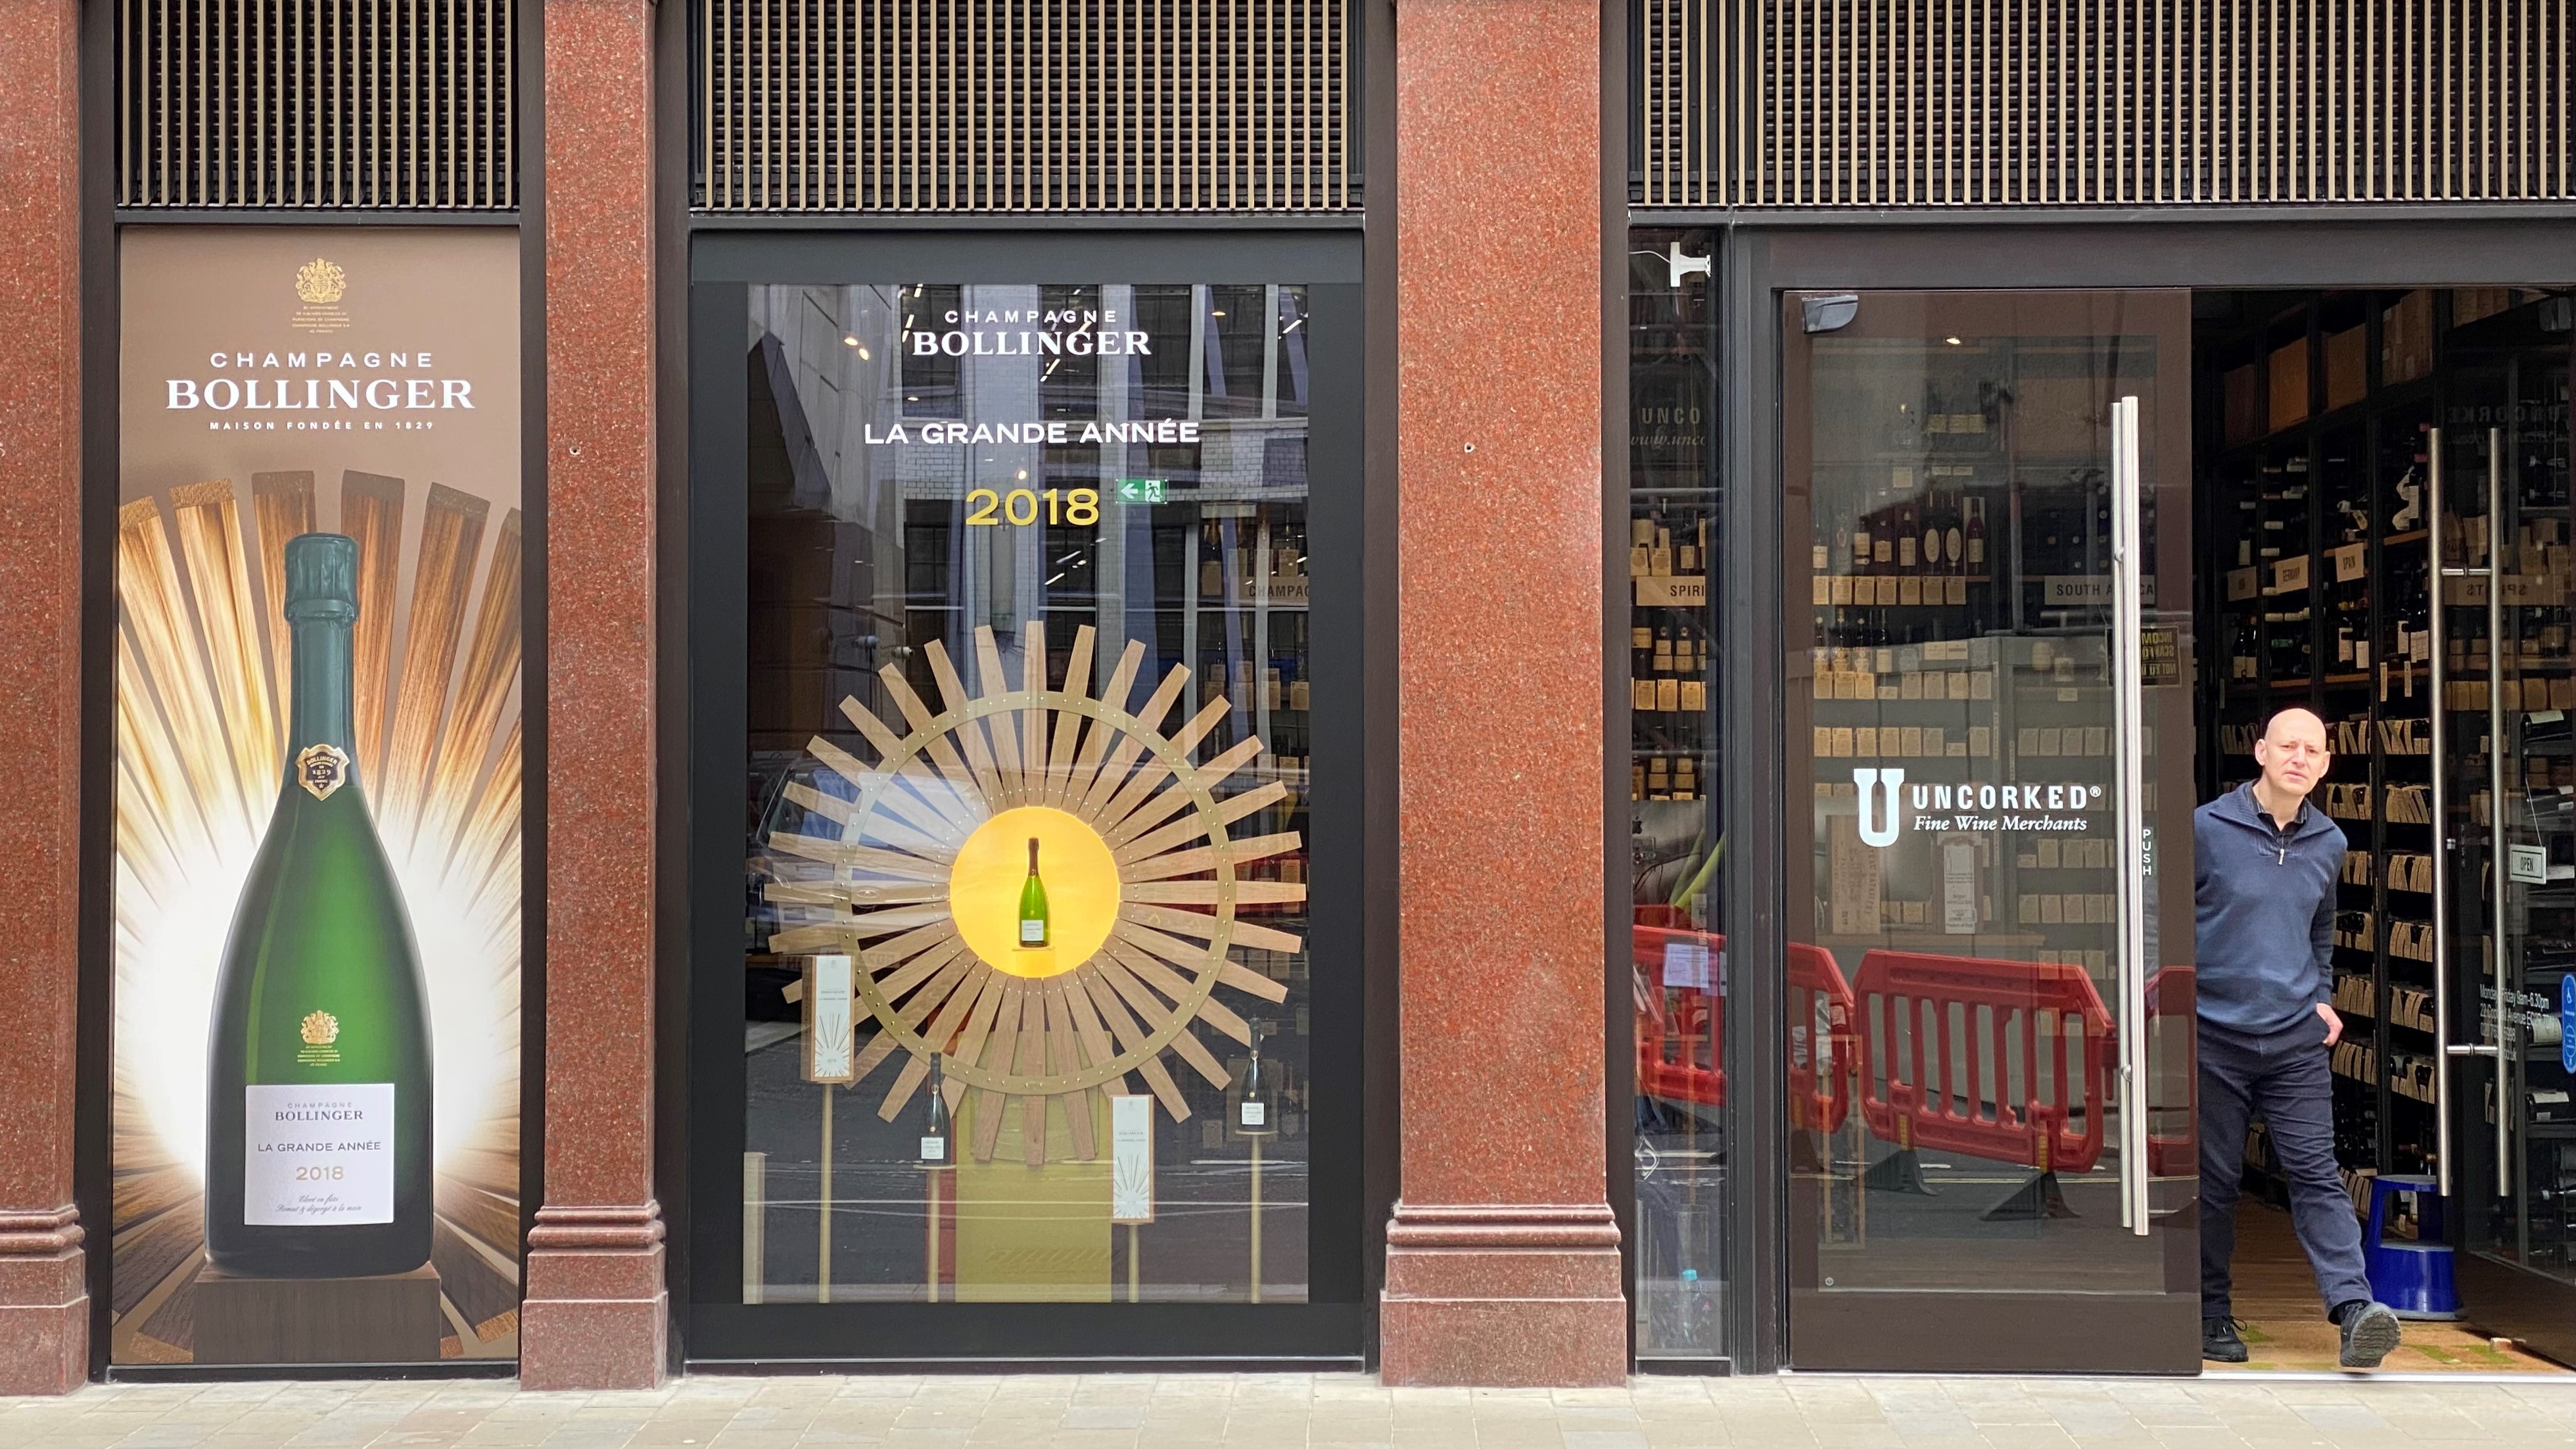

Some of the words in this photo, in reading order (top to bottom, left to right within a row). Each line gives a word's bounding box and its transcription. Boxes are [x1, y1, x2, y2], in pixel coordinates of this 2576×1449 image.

[945, 310, 1117, 323] CHAMPAGNE
[912, 331, 1152, 356] BOLLINGER
[210, 352, 433, 368] CHAMPAGNE
[166, 379, 476, 410] BOLLINGER
[287, 420, 352, 430] FONDÉE
[396, 421, 434, 430] 1829
[864, 423, 909, 444] LA
[922, 423, 1068, 444] GRANDE
[1079, 417, 1200, 444] ANNÉE
[966, 488, 1099, 527] 2018
[2057, 584, 2100, 596] SOUTH
[2106, 584, 2154, 596] ACA
[1913, 816, 1950, 831] Fine
[1955, 816, 1997, 831] Wine
[2001, 815, 2088, 831] Merchants
[2143, 830, 2151, 876] PUSH
[2520, 856, 2534, 872] OPEN
[275, 1110, 363, 1121] BOLLINGER
[258, 1143, 273, 1152] LA
[277, 1143, 333, 1152] GRANDE
[338, 1139, 381, 1151] ANNÉE
[296, 1166, 344, 1181] 2018
